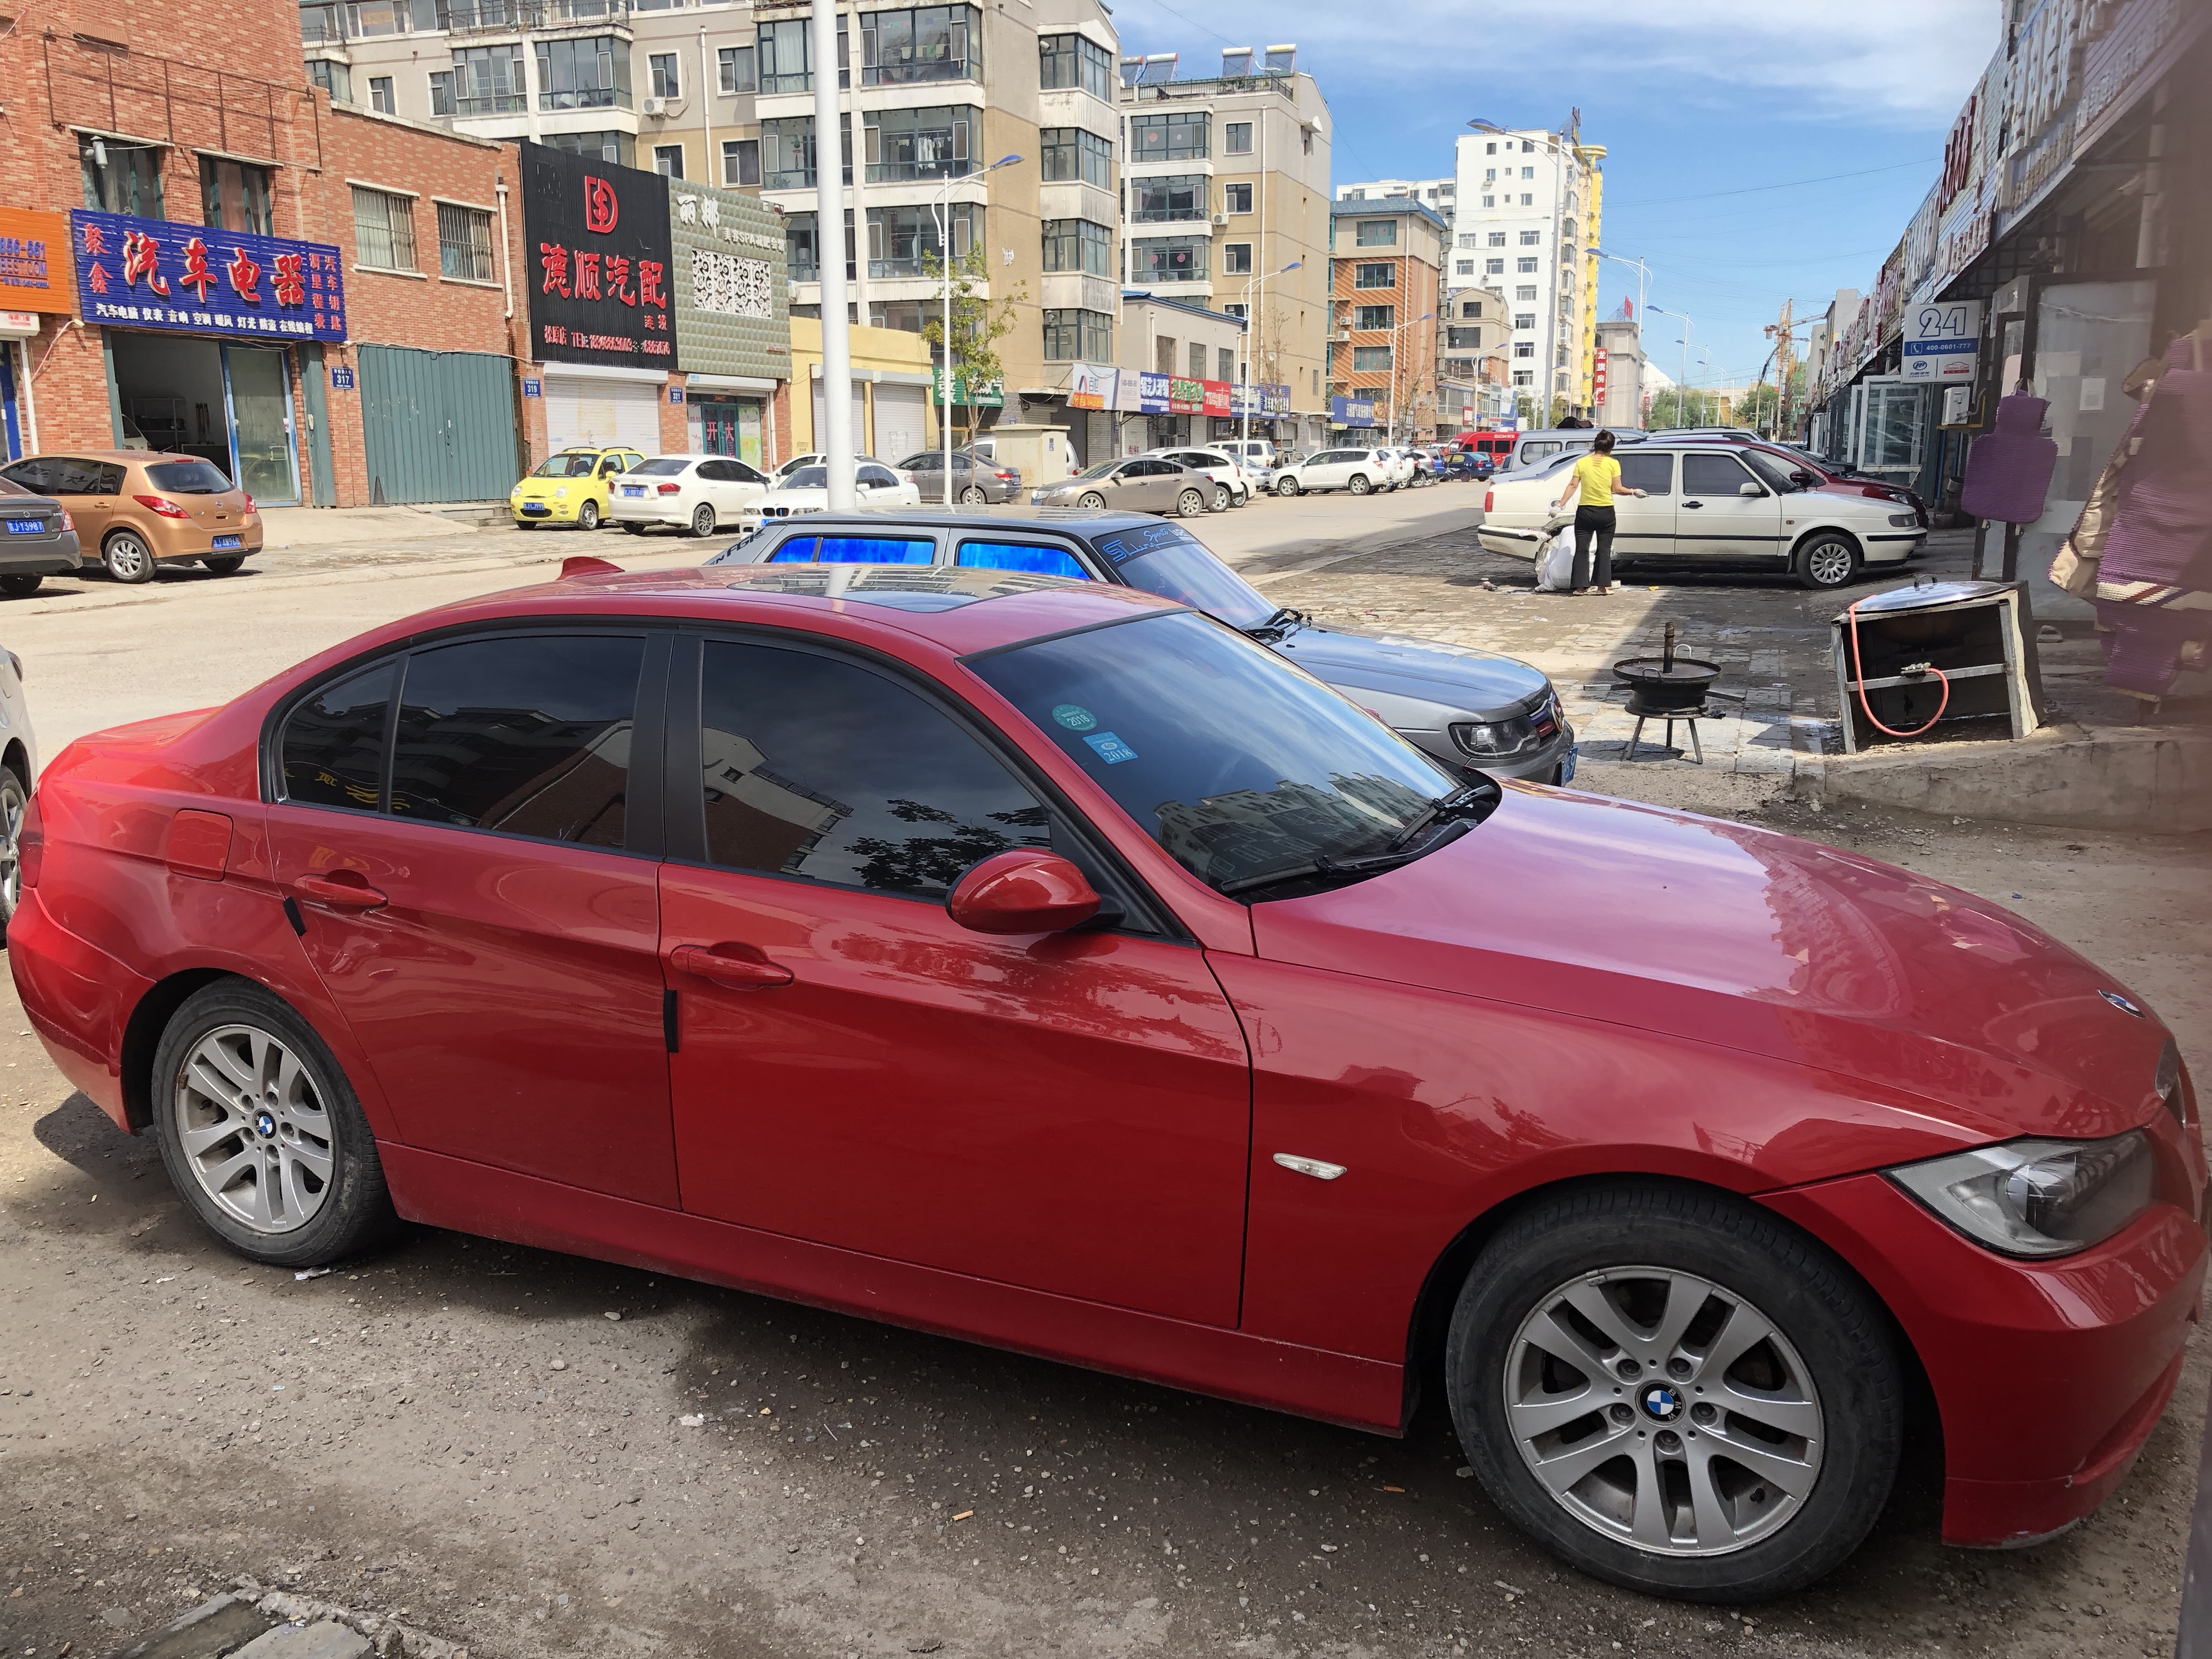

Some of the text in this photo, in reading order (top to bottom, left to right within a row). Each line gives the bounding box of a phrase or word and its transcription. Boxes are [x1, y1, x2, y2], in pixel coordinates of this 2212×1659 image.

[84, 223, 113, 294] 聚鑫
[123, 231, 306, 306] 汽车电器
[309, 253, 325, 329] 调里程表
[540, 242, 666, 309] 德顺汽配
[325, 255, 342, 331] 汽车钥匙
[96, 303, 314, 334] 汽车电脑 仪表 音响 空调 暖风 灯光 防盗 在线编程
[1919, 307, 1966, 338] 24
[544, 325, 567, 346] 松原店
[337, 375, 349, 384] 317
[1596, 350, 1606, 394] 龙旗房产
[1066, 714, 1090, 726] 2018
[1104, 748, 1133, 761] 2018
[1668, 1388, 1681, 1420] BMW
